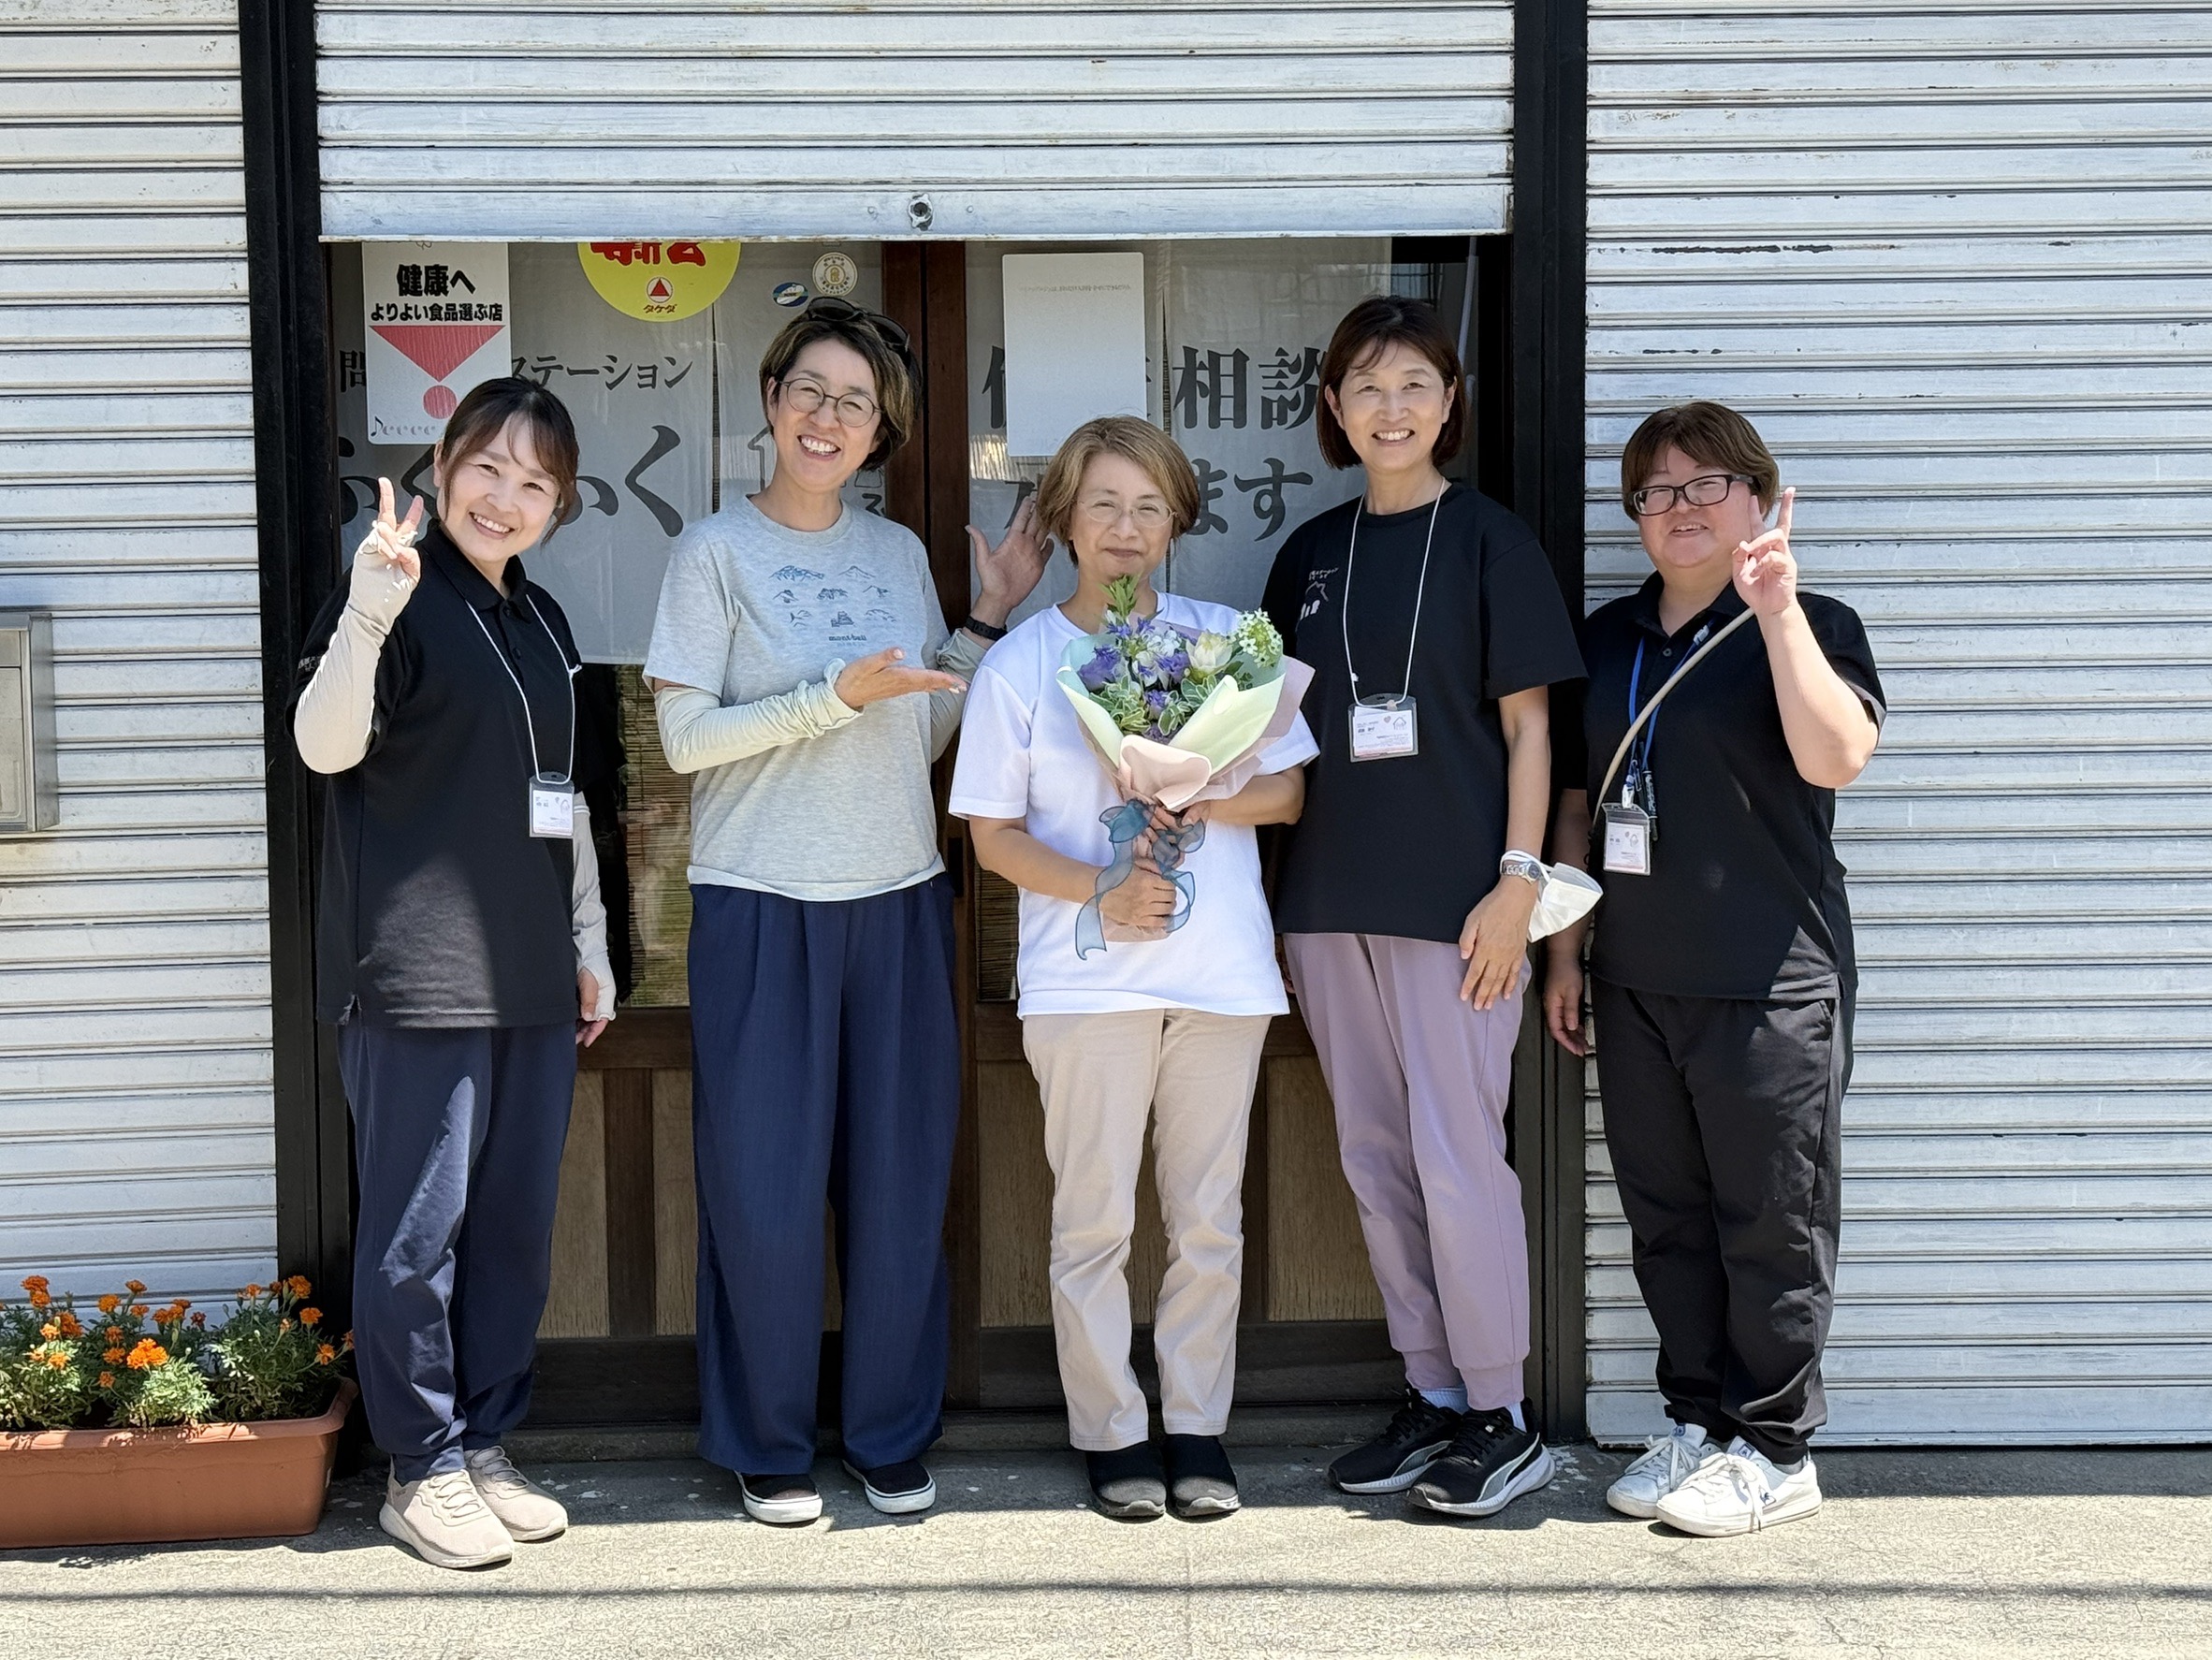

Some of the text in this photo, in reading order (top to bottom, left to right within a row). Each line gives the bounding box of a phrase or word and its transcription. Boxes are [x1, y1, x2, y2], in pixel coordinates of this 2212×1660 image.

[397, 264, 476, 298] 健康へ
[371, 302, 503, 322] よりよい食品選ぶ店
[643, 303, 677, 314] タケダ
